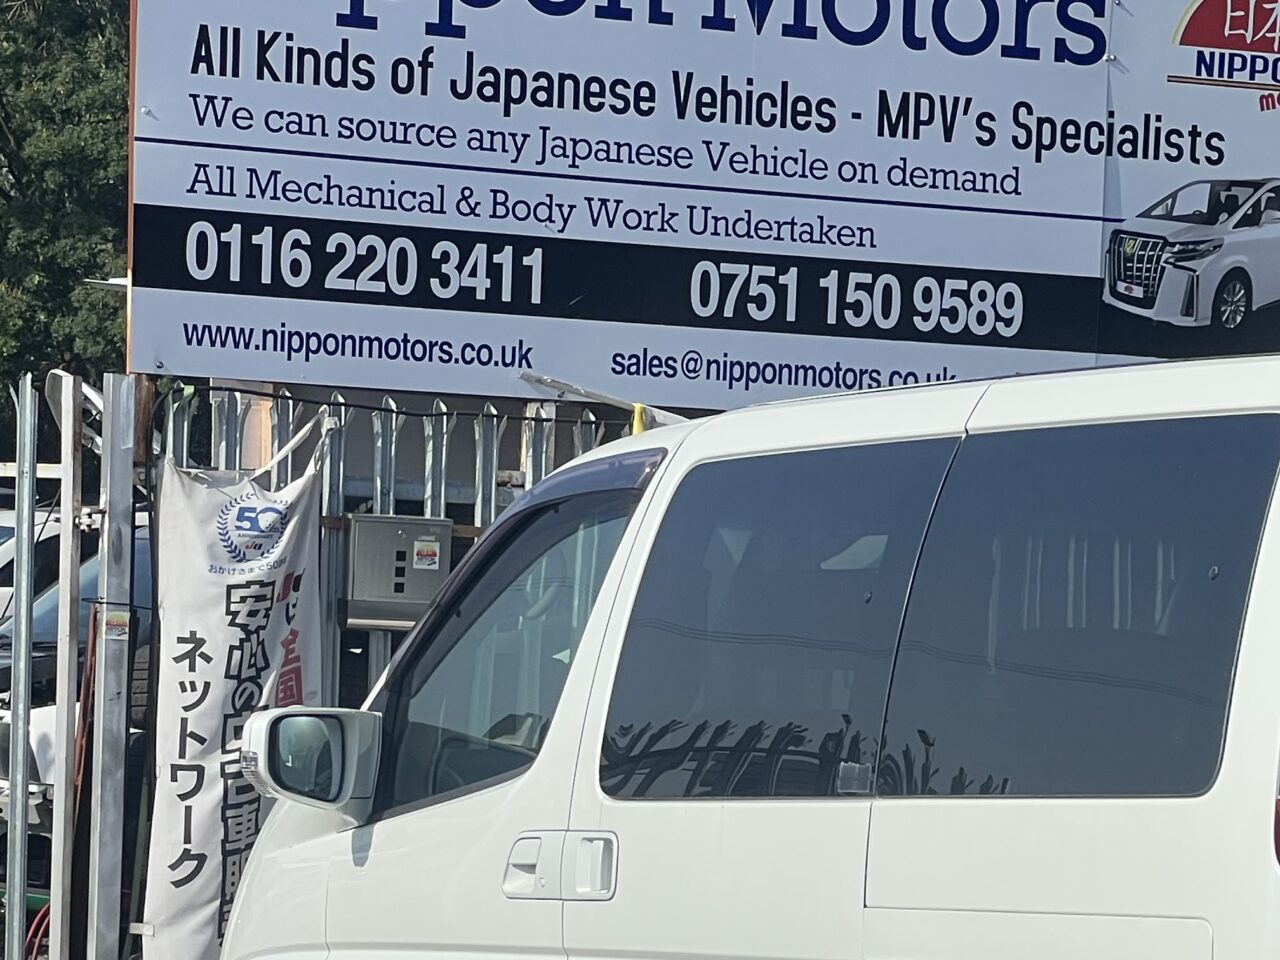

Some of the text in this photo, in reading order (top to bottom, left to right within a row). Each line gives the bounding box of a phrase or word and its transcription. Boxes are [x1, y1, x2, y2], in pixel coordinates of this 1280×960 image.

[190, 23, 241, 79] All
[256, 29, 376, 92] Kinds
[390, 45, 435, 97] of
[449, 50, 656, 118] Japanese
[671, 70, 837, 134] Vehicles
[877, 89, 997, 147] MPV's
[1011, 100, 1226, 166] Specialists
[188, 93, 1022, 196] We can source any Japanese Vehicle on demand
[185, 163, 877, 249] All Mechanical & Body Work Undertaken
[185, 220, 543, 304] 0116 220 3411
[690, 260, 1024, 338] 0751 150 9589
[182, 322, 534, 369] www.nipponmotors.co.uk
[610, 347, 957, 392] sales@nipponmotorsco
[168, 630, 213, 890] ネットワーク
